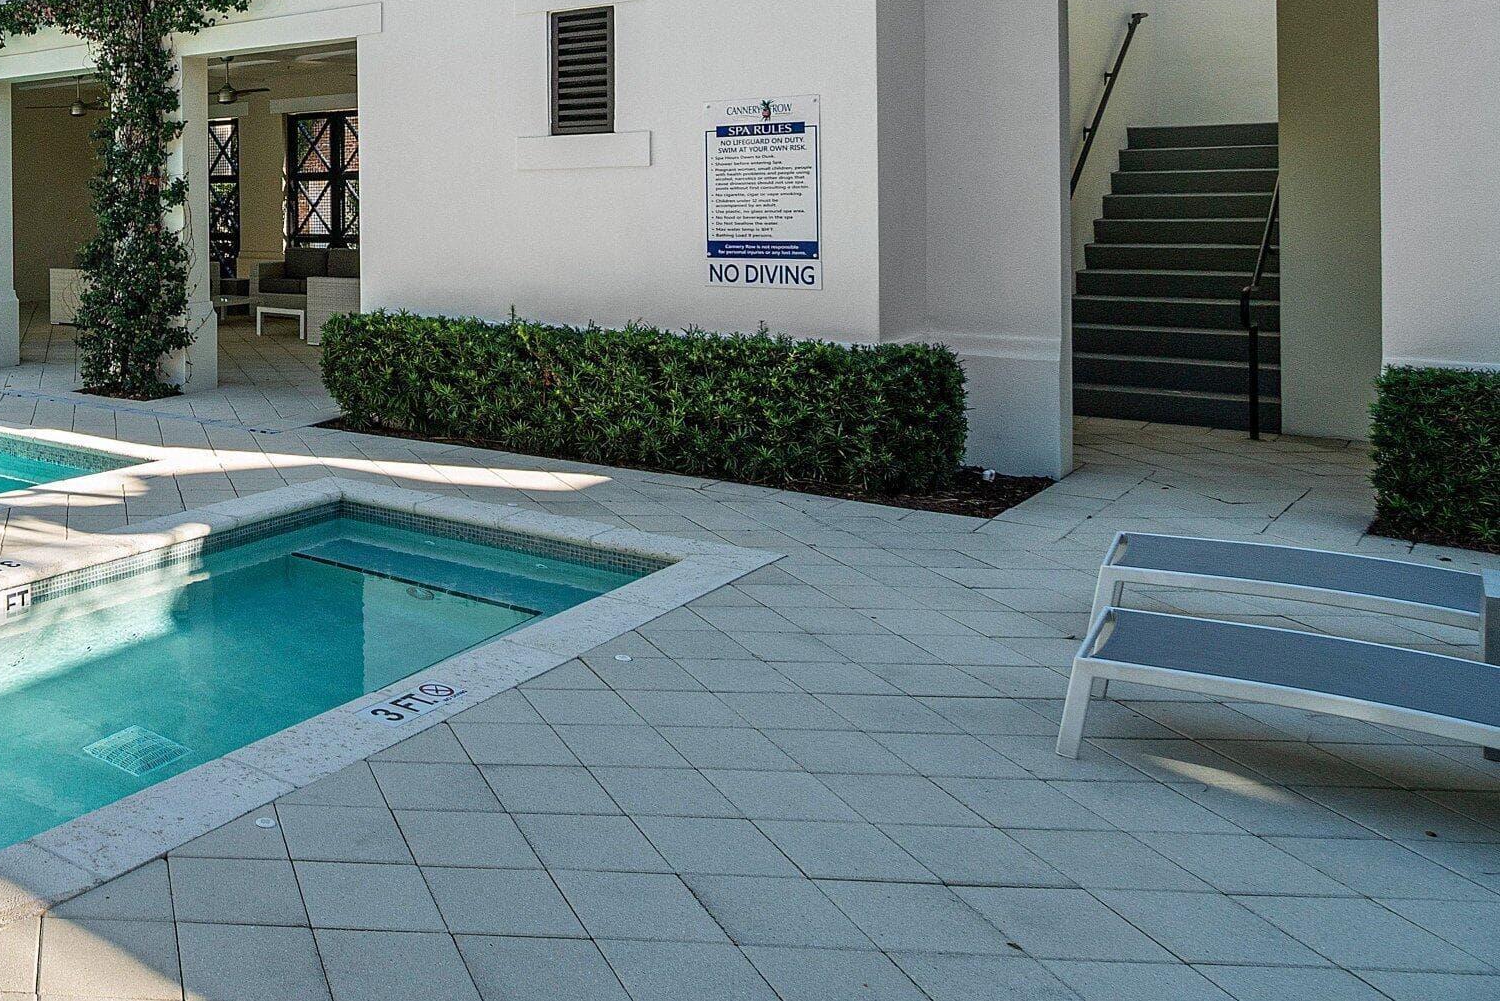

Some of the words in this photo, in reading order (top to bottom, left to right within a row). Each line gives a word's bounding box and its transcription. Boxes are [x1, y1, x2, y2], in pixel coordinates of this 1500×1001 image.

[726, 105, 761, 116] CANNERY
[772, 103, 793, 113] ROW
[728, 126, 751, 136] SPA
[753, 123, 792, 135] RULES
[720, 139, 731, 147] NO
[733, 138, 770, 146] LIFEGUARD
[749, 145, 768, 153] YOUR
[769, 144, 788, 152] OWN
[709, 263, 739, 283] NO
[745, 264, 815, 285] DIVING
[370, 708, 405, 722] 3
[389, 693, 439, 713] FT.
